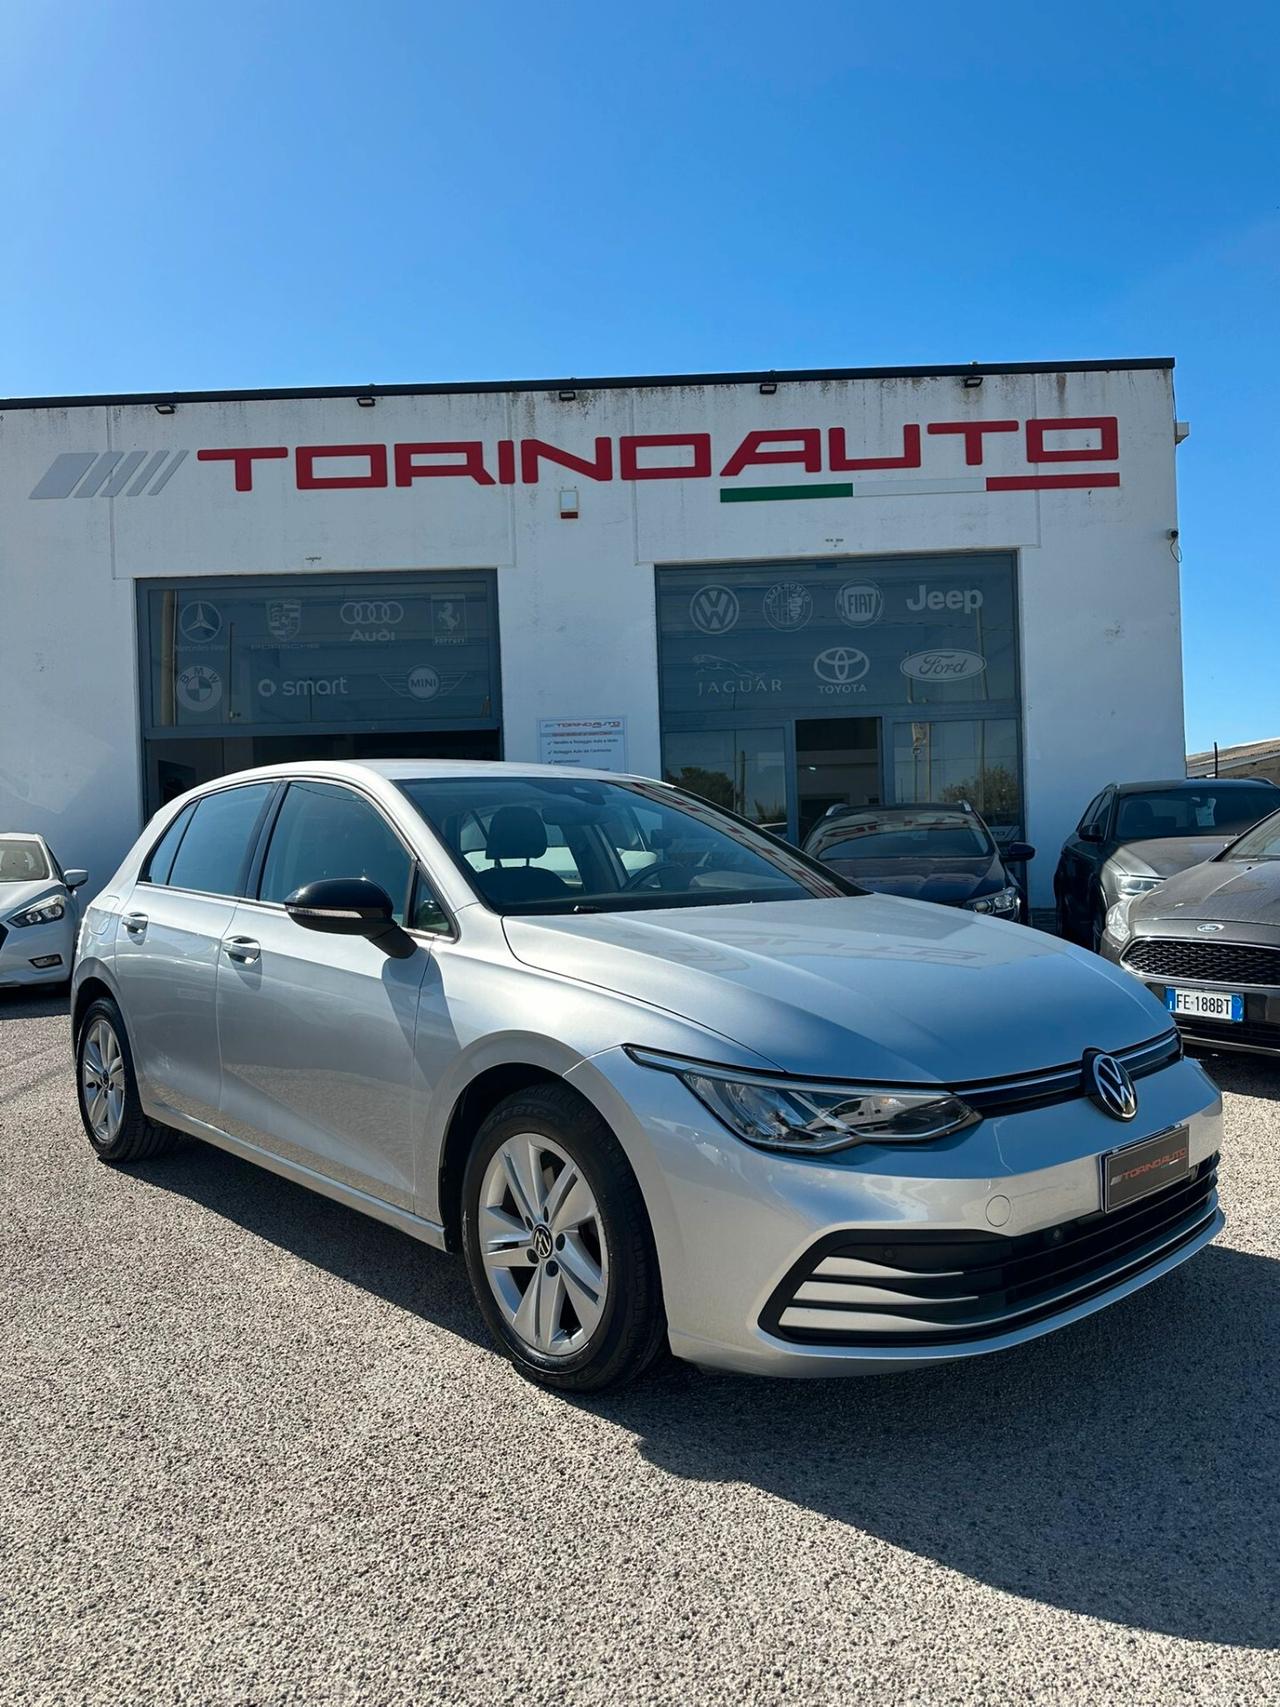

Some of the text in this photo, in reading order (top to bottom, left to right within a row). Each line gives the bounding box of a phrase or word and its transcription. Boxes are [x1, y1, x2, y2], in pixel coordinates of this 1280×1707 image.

[197, 416, 1119, 492] TORINOAUTO
[849, 592, 874, 614] FIAT
[906, 584, 984, 614] Jeep
[349, 629, 396, 641] Audi
[918, 654, 968, 675] Ford
[282, 676, 349, 696] smart
[409, 678, 437, 689] MINI
[698, 679, 783, 697] JAGUAR
[818, 684, 868, 694] TOYOTA
